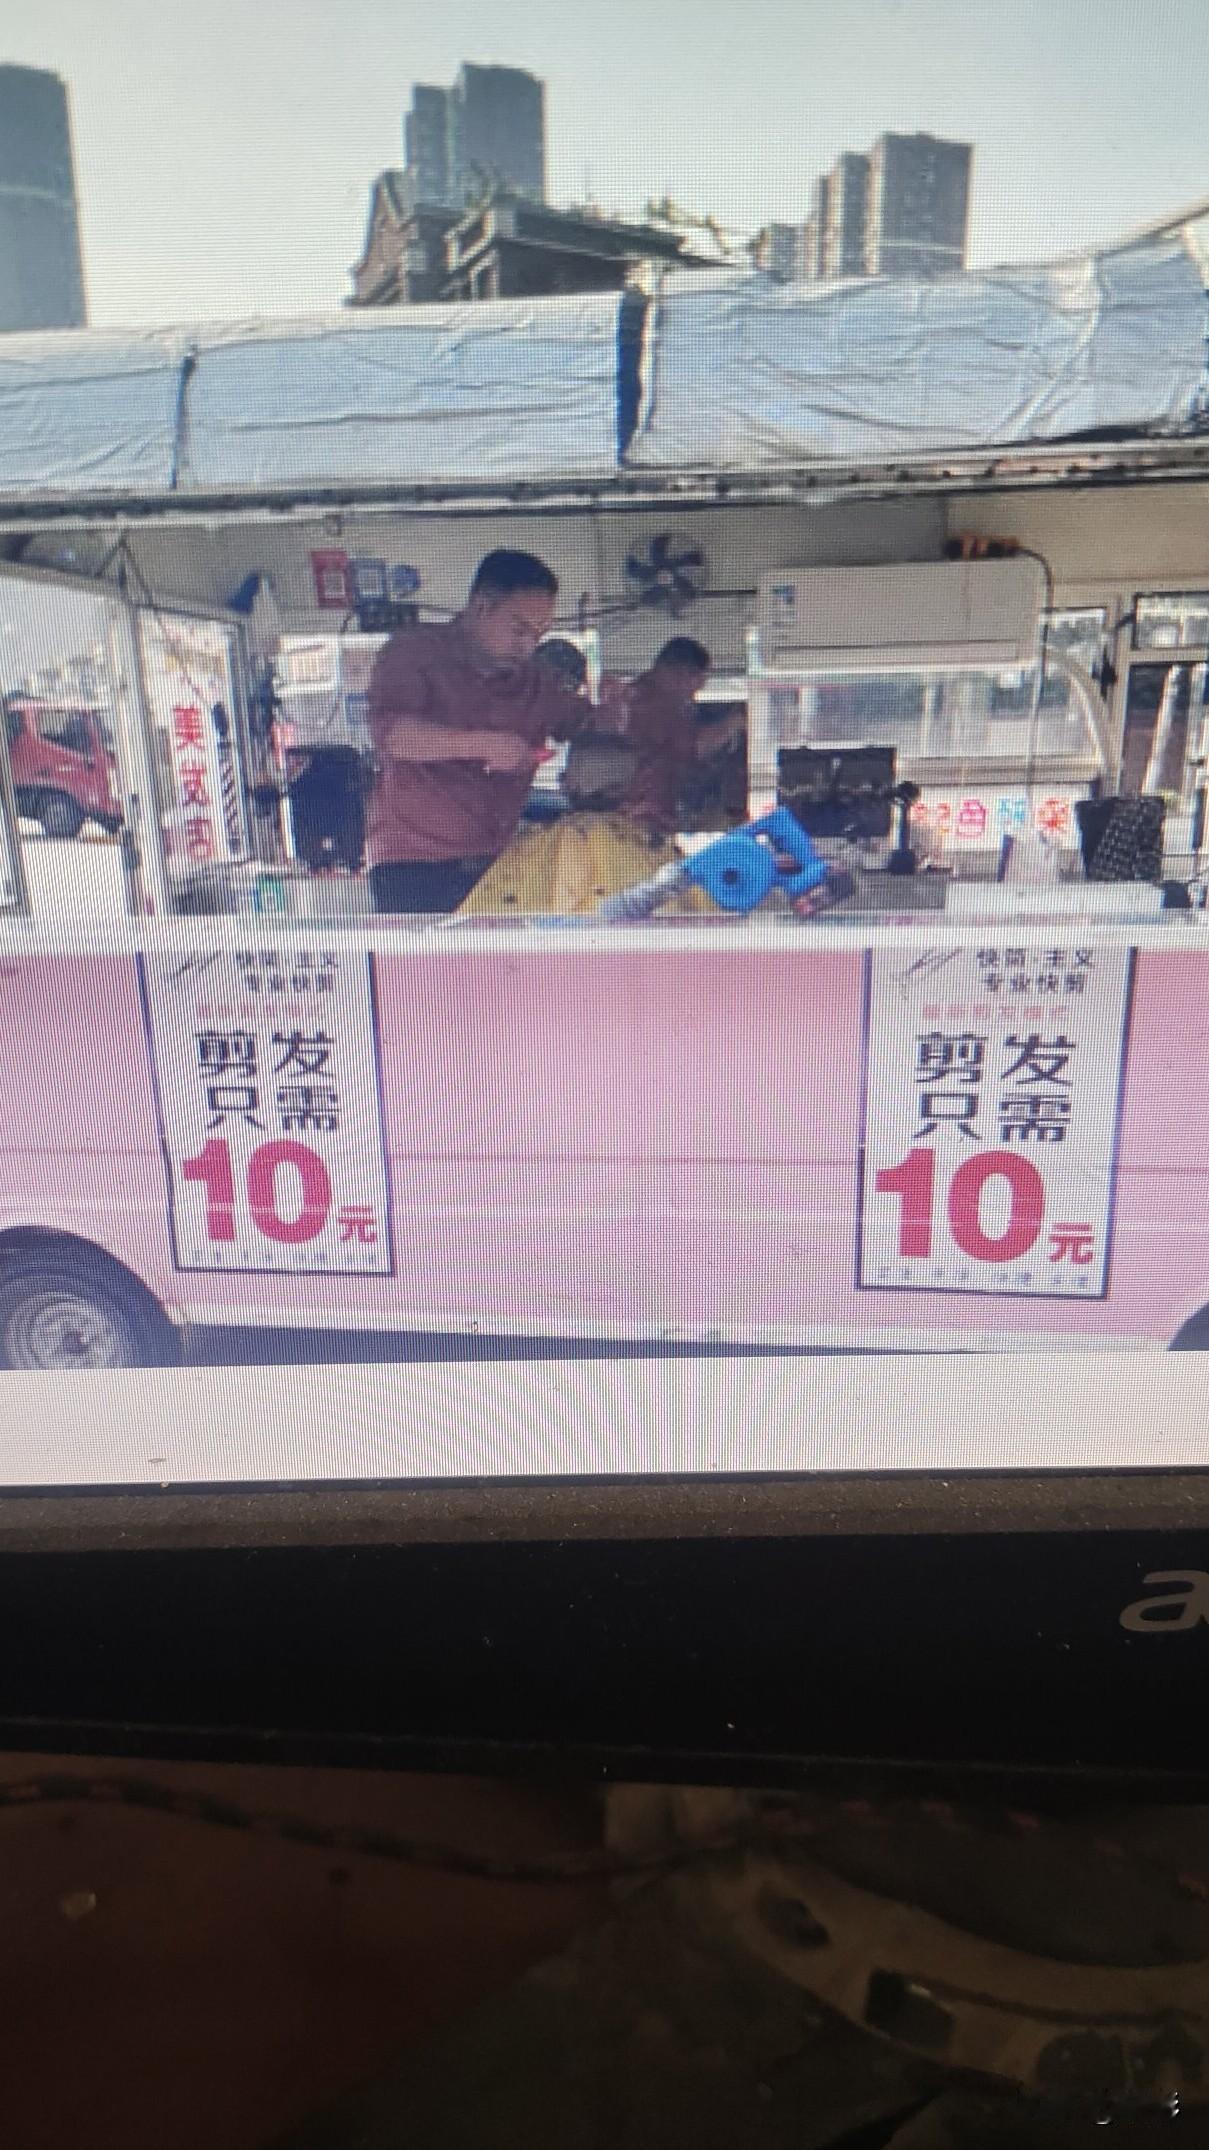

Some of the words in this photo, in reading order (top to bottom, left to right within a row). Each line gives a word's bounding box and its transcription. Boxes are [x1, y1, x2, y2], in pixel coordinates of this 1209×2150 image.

[194, 1030, 335, 1079] 剪发
[914, 1031, 1077, 1087] 剪发
[205, 1084, 340, 1132] 只需
[911, 1092, 1074, 1143] 只需
[1119, 1569, 1209, 1632] a
